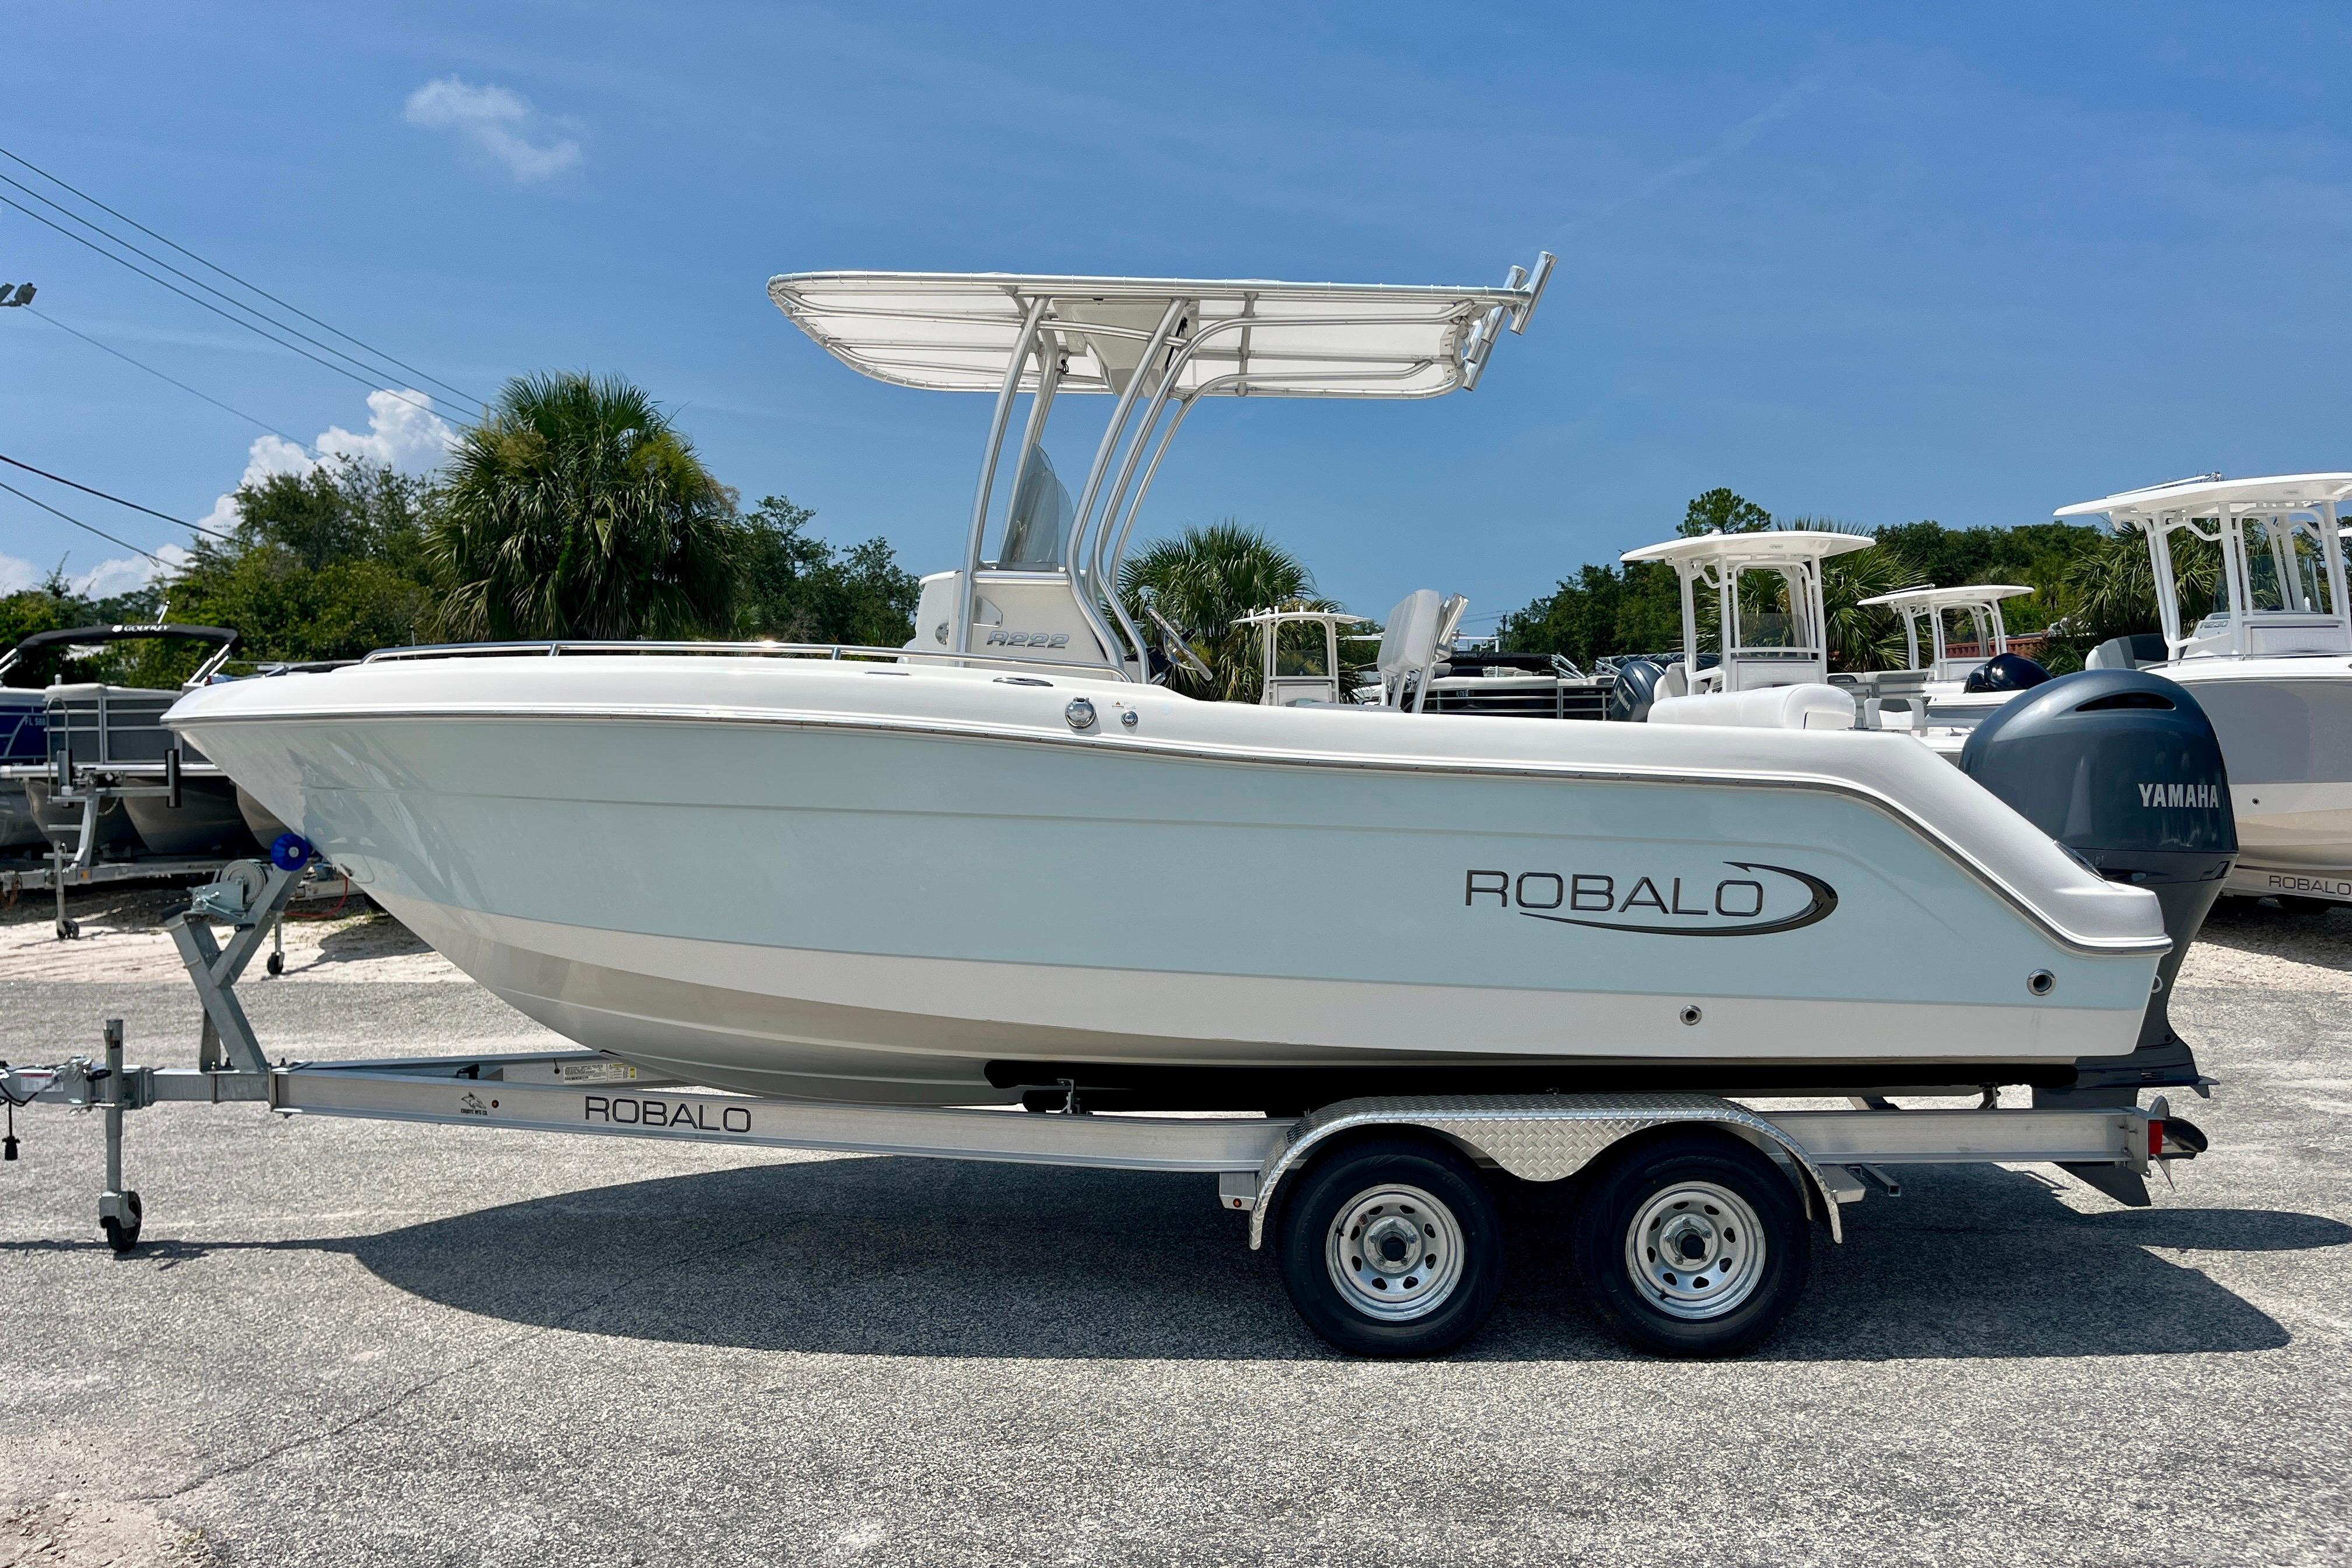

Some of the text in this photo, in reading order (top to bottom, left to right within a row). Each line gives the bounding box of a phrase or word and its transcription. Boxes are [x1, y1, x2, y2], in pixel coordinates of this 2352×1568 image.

[986, 631, 1070, 649] R222
[2137, 783, 2220, 808] YAMAHA
[1465, 869, 1763, 917] ROBALO
[2269, 875, 2352, 895] ROBALO
[585, 1096, 752, 1133] ROBALO
